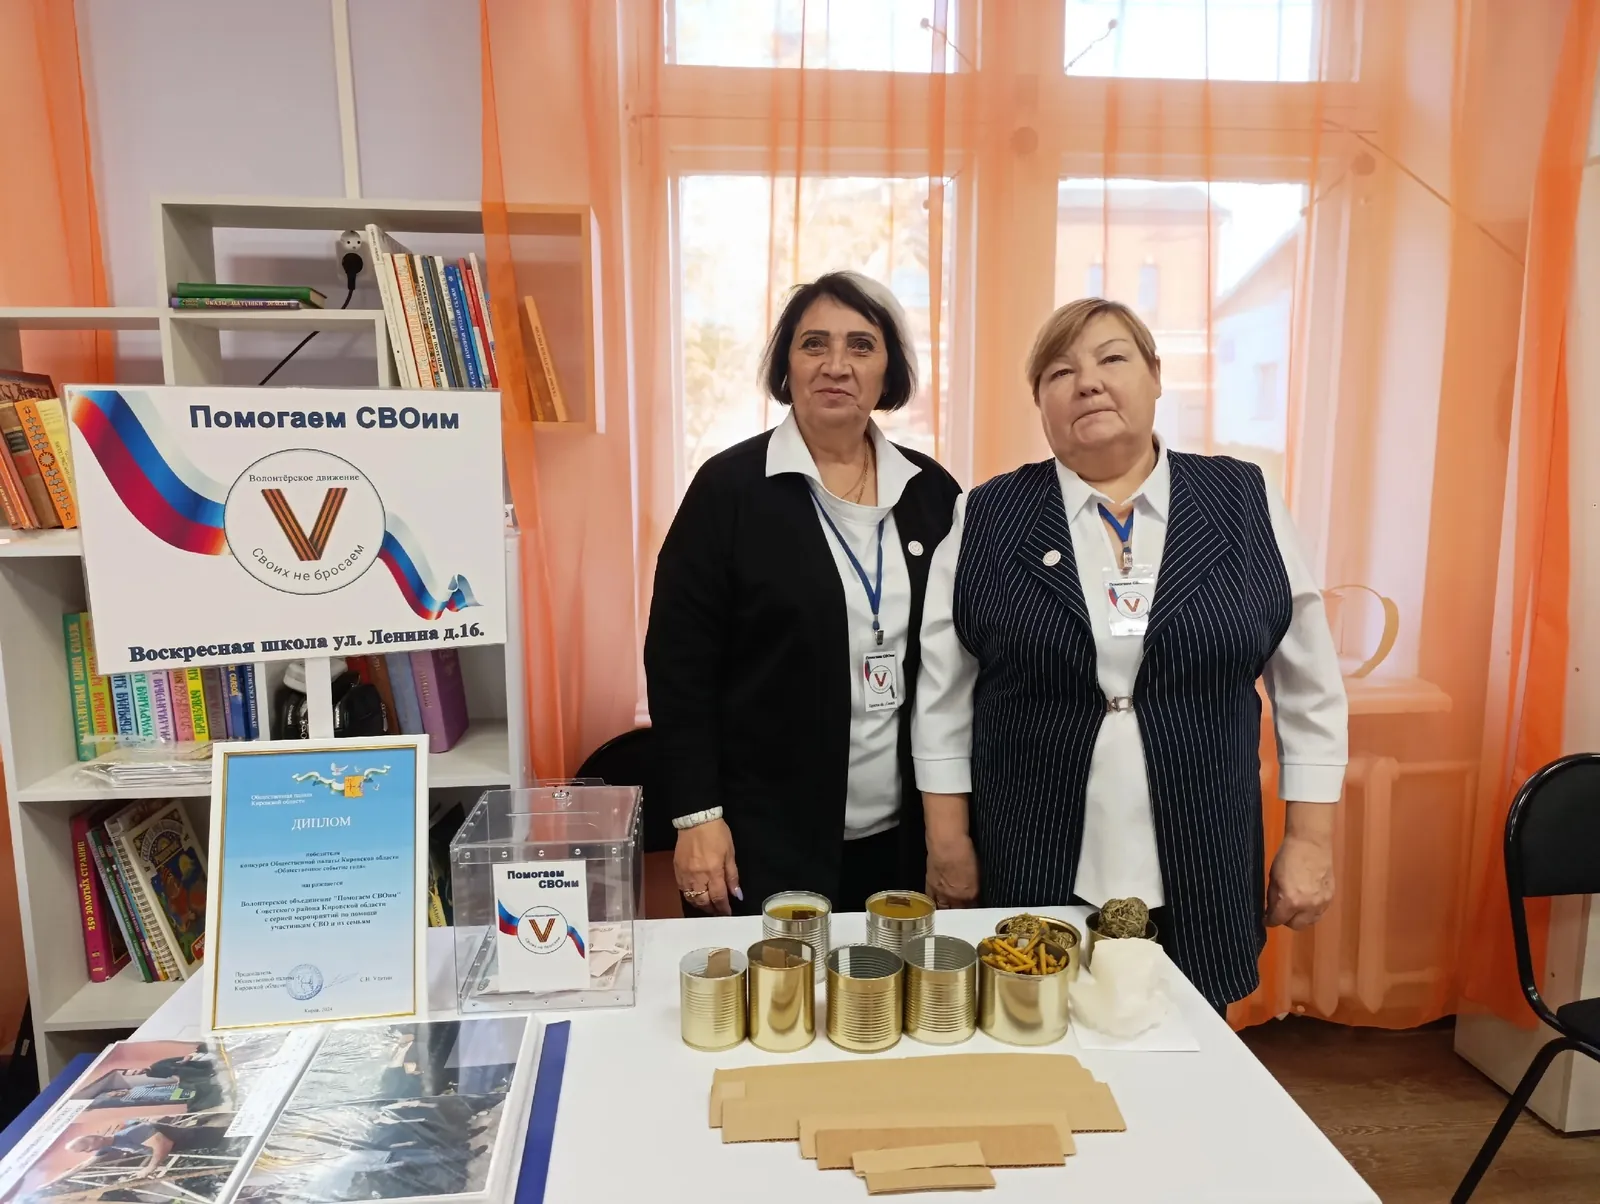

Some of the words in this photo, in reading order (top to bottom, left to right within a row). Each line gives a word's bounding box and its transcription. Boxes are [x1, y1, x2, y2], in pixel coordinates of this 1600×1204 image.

[419, 275, 428, 303] РУССКИЕ
[427, 306, 435, 335] СКАЗКИ
[434, 341, 444, 373] ПОТЕШКИ
[189, 405, 346, 429] Помогаем
[356, 406, 460, 429] СВОим
[249, 474, 313, 483] Волонтёрское
[316, 474, 360, 482] движение
[252, 547, 290, 578] Своих
[293, 571, 311, 581] не
[314, 544, 365, 581] бросаем
[128, 641, 255, 662] Воскресная
[261, 637, 328, 652] школа
[333, 635, 362, 650] ул.
[367, 628, 439, 645] Ленина
[443, 623, 485, 641] д.16.
[246, 672, 254, 698] СКАЗКИ
[190, 689, 205, 734] БРОНЗОВАЯ
[291, 816, 351, 831] ДИПЛОМ
[76, 840, 88, 877] СТРАНИЦ
[507, 870, 565, 880] Помогаем
[538, 879, 579, 889] СВОим
[82, 877, 93, 915] ЗОЛОТЫХ
[321, 903, 358, 911] Кировской
[86, 915, 95, 931] 250
